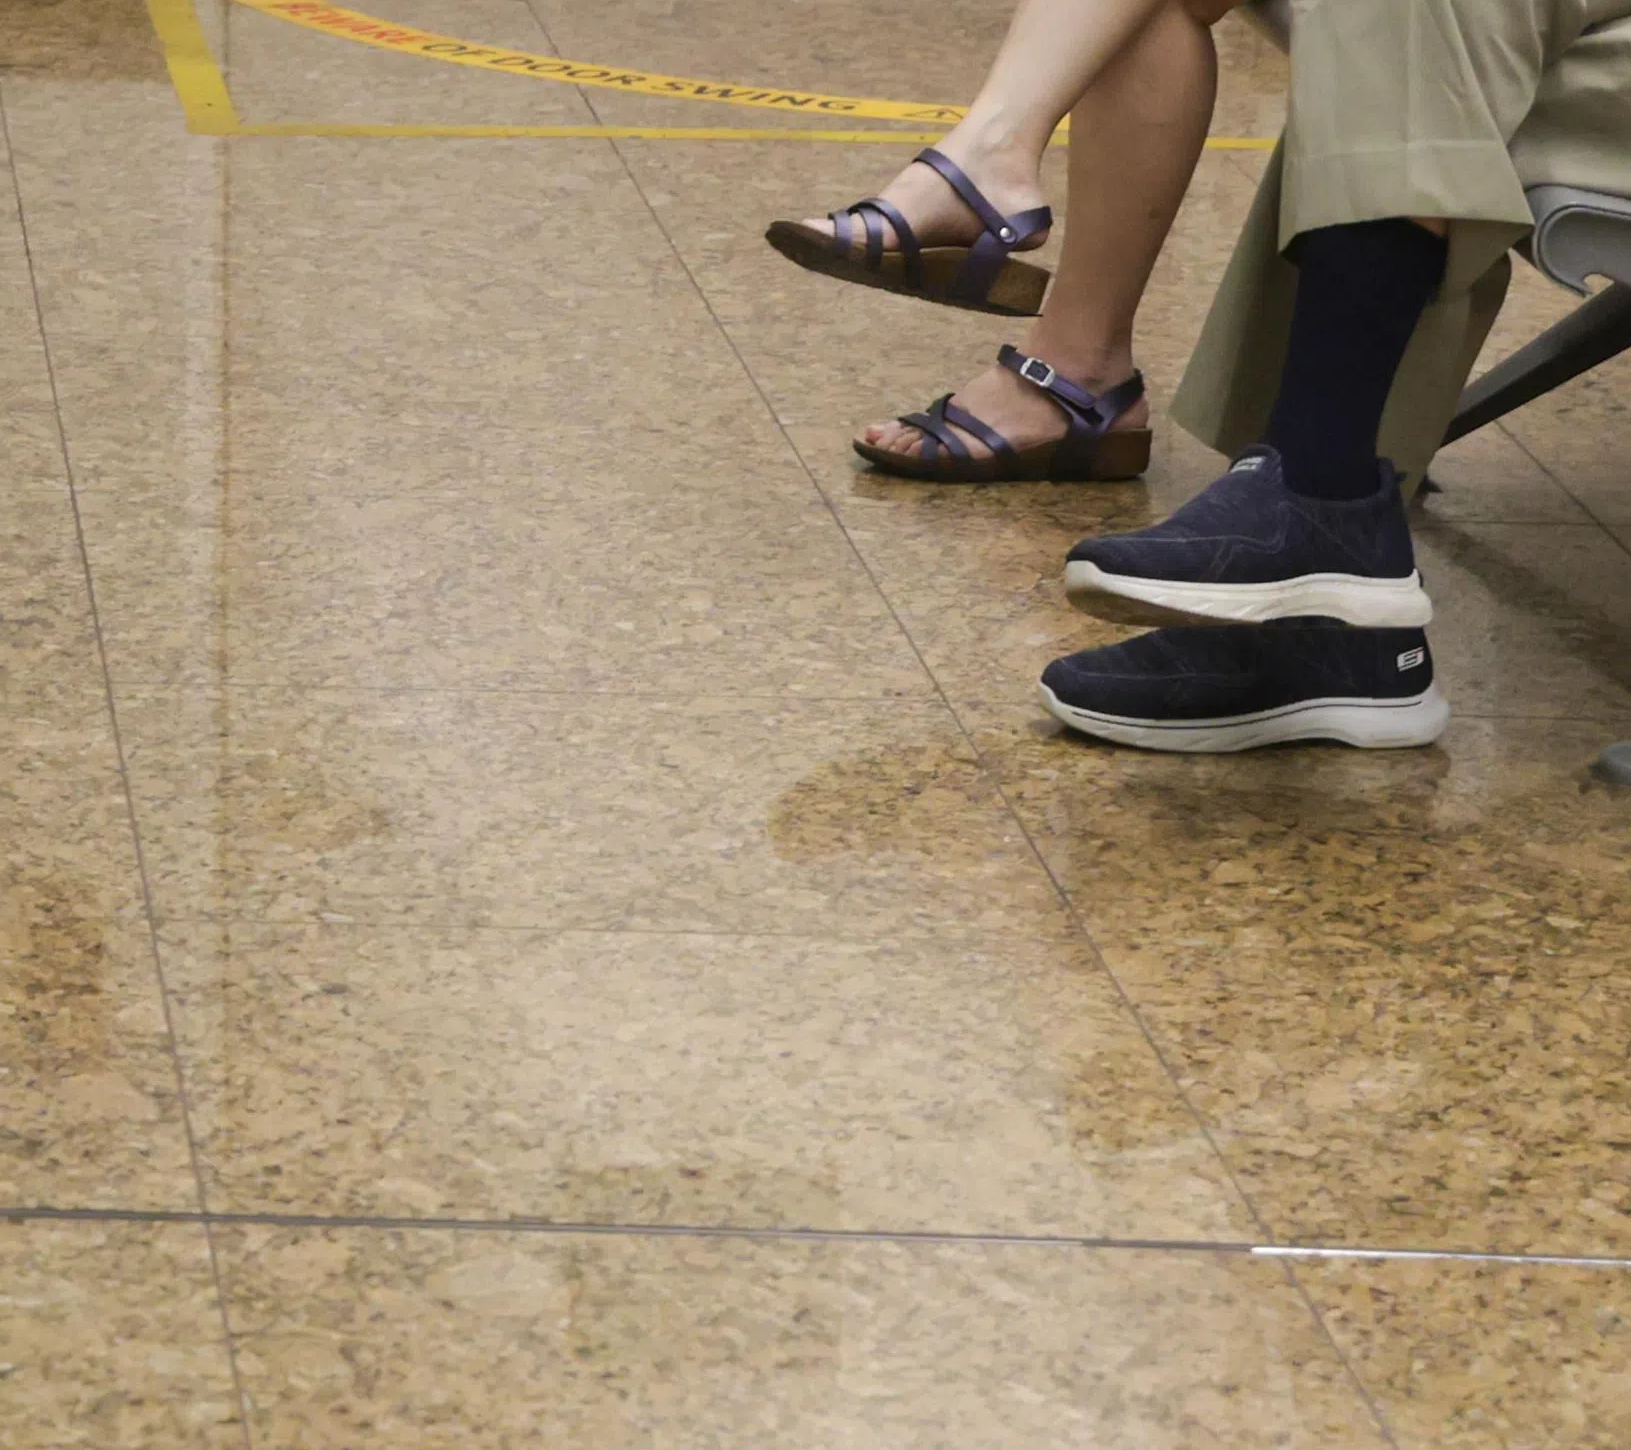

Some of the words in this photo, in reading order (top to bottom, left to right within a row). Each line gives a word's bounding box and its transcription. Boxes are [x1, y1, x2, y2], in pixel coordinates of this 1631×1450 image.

[272, 2, 432, 45] BEWARE
[423, 43, 497, 56] OF
[488, 57, 647, 86] DOOR
[652, 81, 861, 111] SWING
